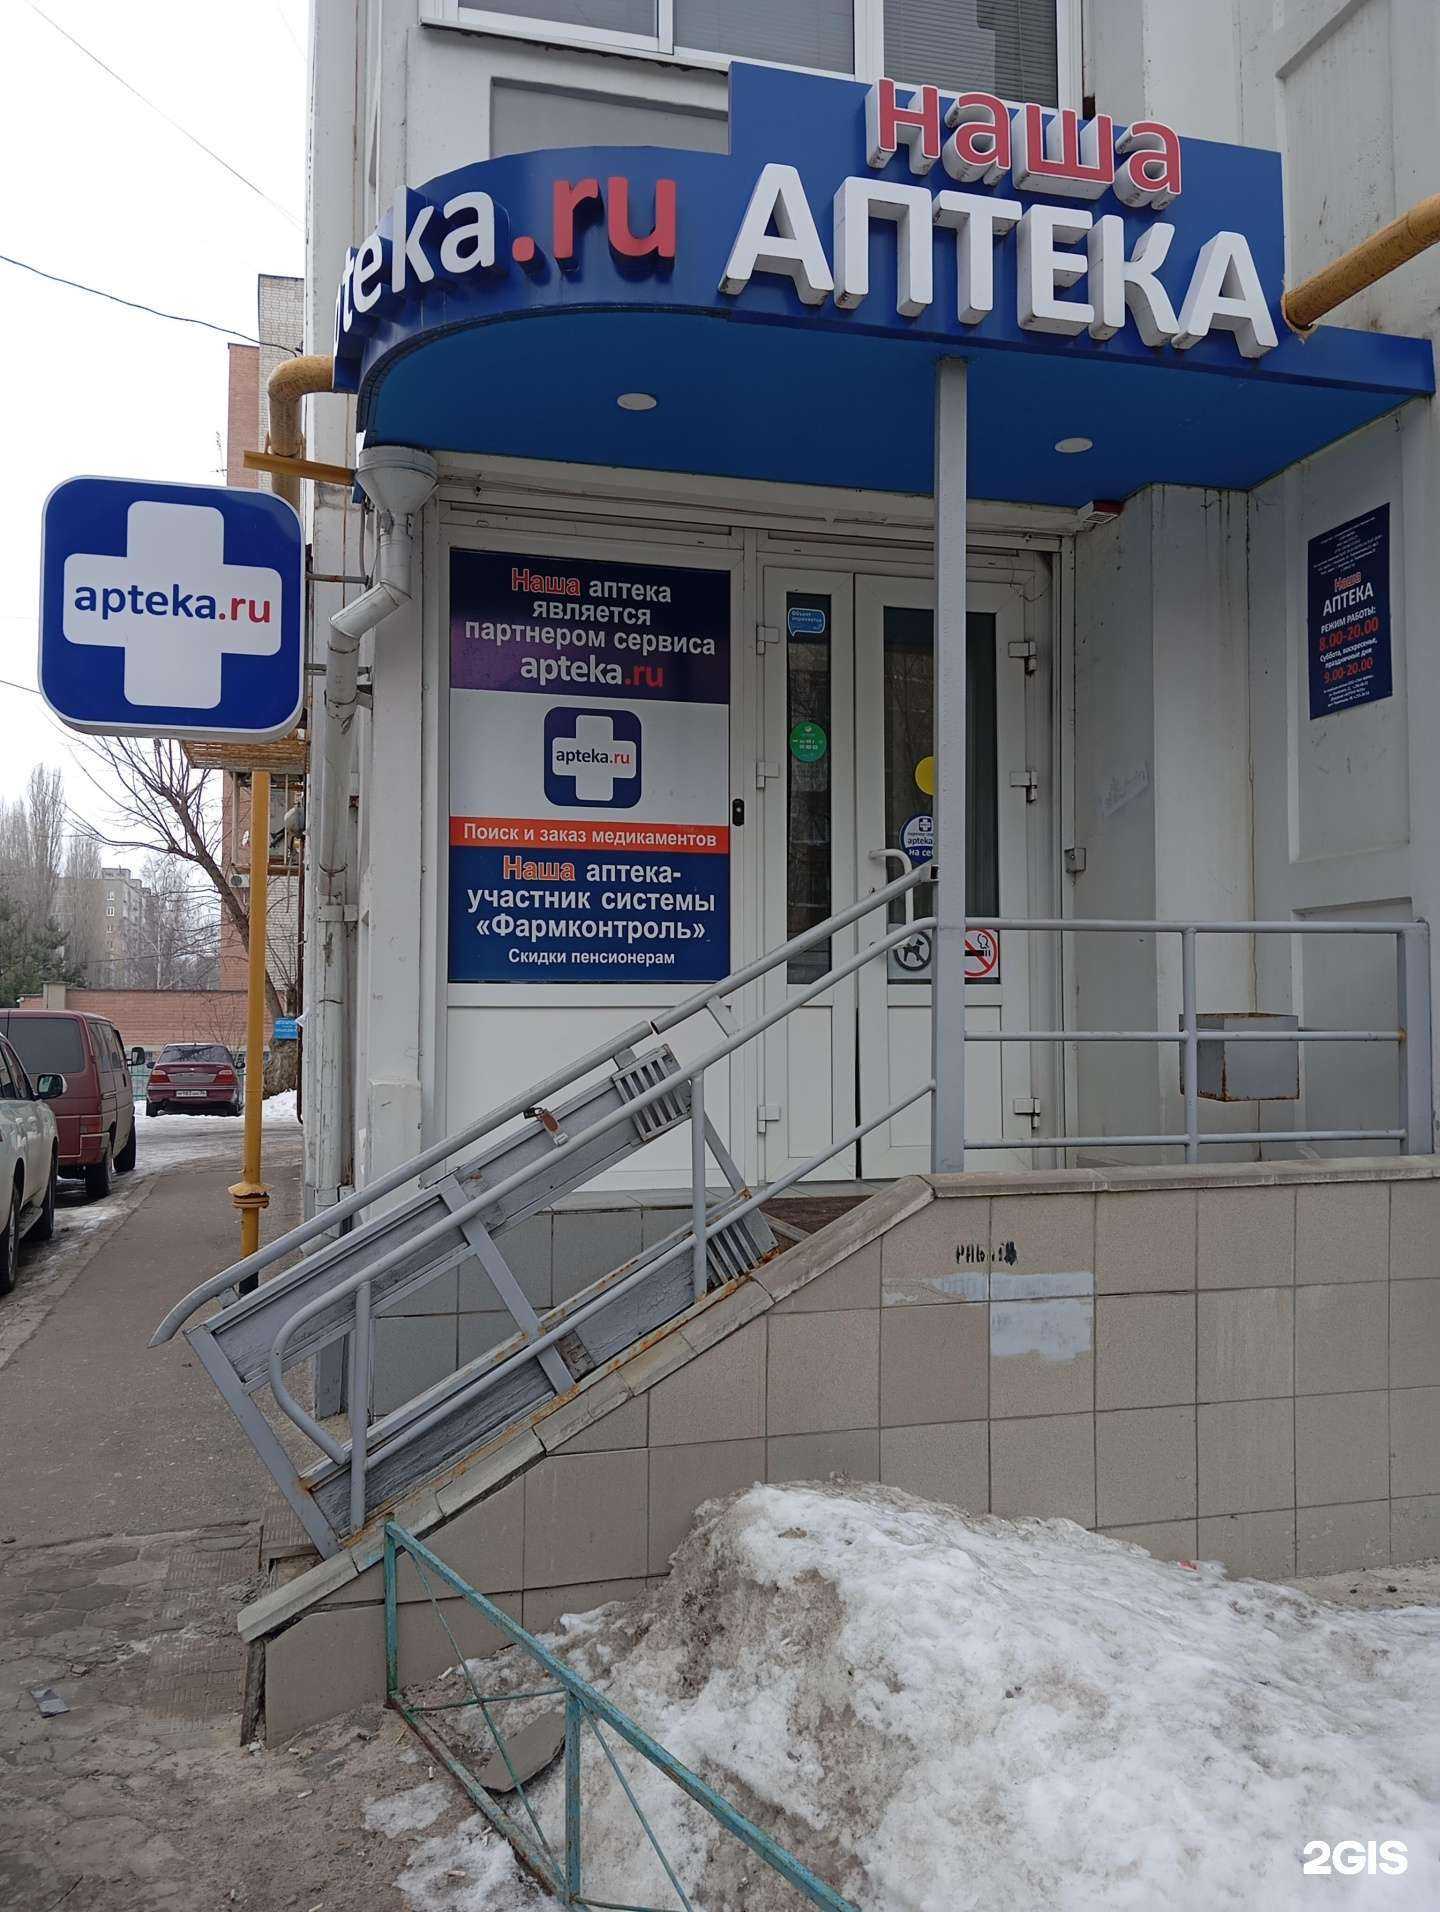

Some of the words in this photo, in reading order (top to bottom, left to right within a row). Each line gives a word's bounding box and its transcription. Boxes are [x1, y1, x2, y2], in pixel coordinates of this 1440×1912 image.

[717, 163, 1278, 357] АПТЕКА
[511, 567, 581, 597] Наша
[588, 579, 672, 604] аптека
[1322, 582, 1374, 616] АПТЕКА
[73, 583, 271, 624] apteka.ru
[532, 600, 652, 627] является
[464, 620, 606, 651] партнером
[613, 630, 716, 656] сервиса
[1320, 617, 1346, 635] РЕЖИМ
[519, 654, 665, 688] apteka.ru
[555, 747, 631, 766] apteka.ru
[463, 823, 519, 842] Поиск
[523, 827, 535, 841] и
[539, 828, 587, 844] заказ
[591, 829, 717, 848] медикаментов
[907, 837, 933, 845] apteka
[502, 855, 576, 881] Наша
[586, 863, 682, 884] аптека-
[466, 888, 591, 913] участник
[601, 890, 715, 912] системы
[475, 913, 706, 944] «Фармконтроль»
[508, 948, 566, 965] Скидки
[571, 950, 675, 965] пенсионерам
